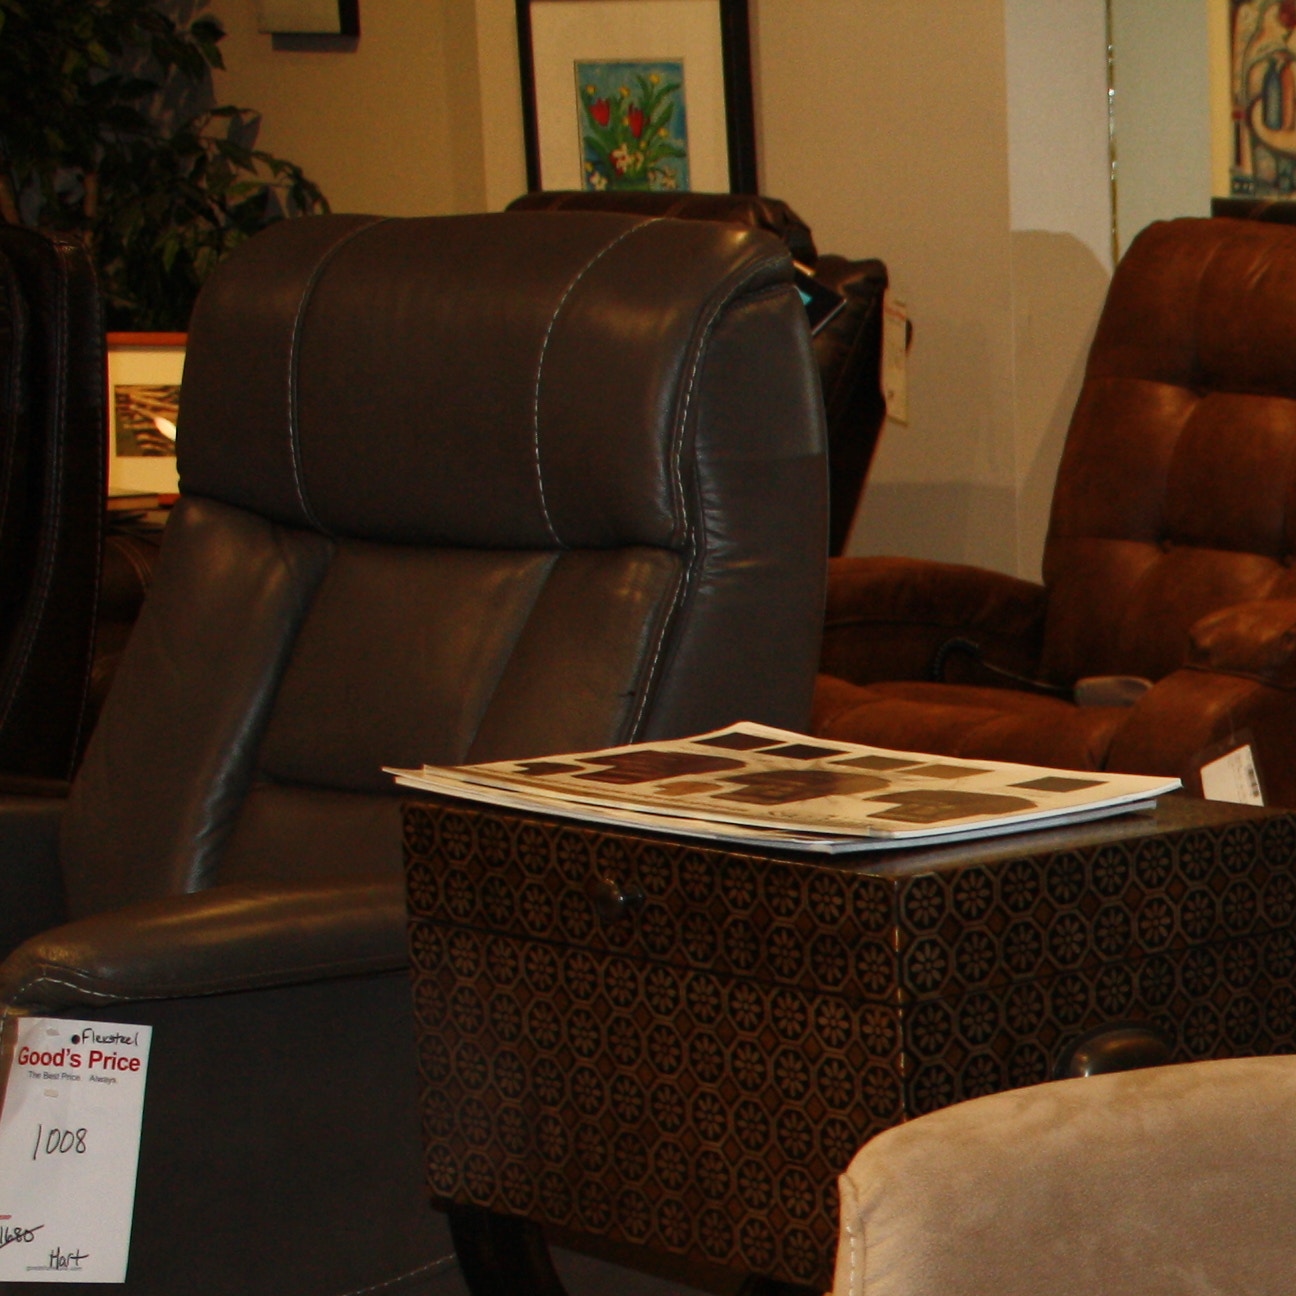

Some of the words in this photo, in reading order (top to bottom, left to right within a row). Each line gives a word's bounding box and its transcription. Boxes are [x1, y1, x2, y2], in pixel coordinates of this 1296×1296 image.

[18, 1046, 82, 1068] Good's
[88, 1050, 141, 1072] Price
[33, 1123, 88, 1161] 1008
